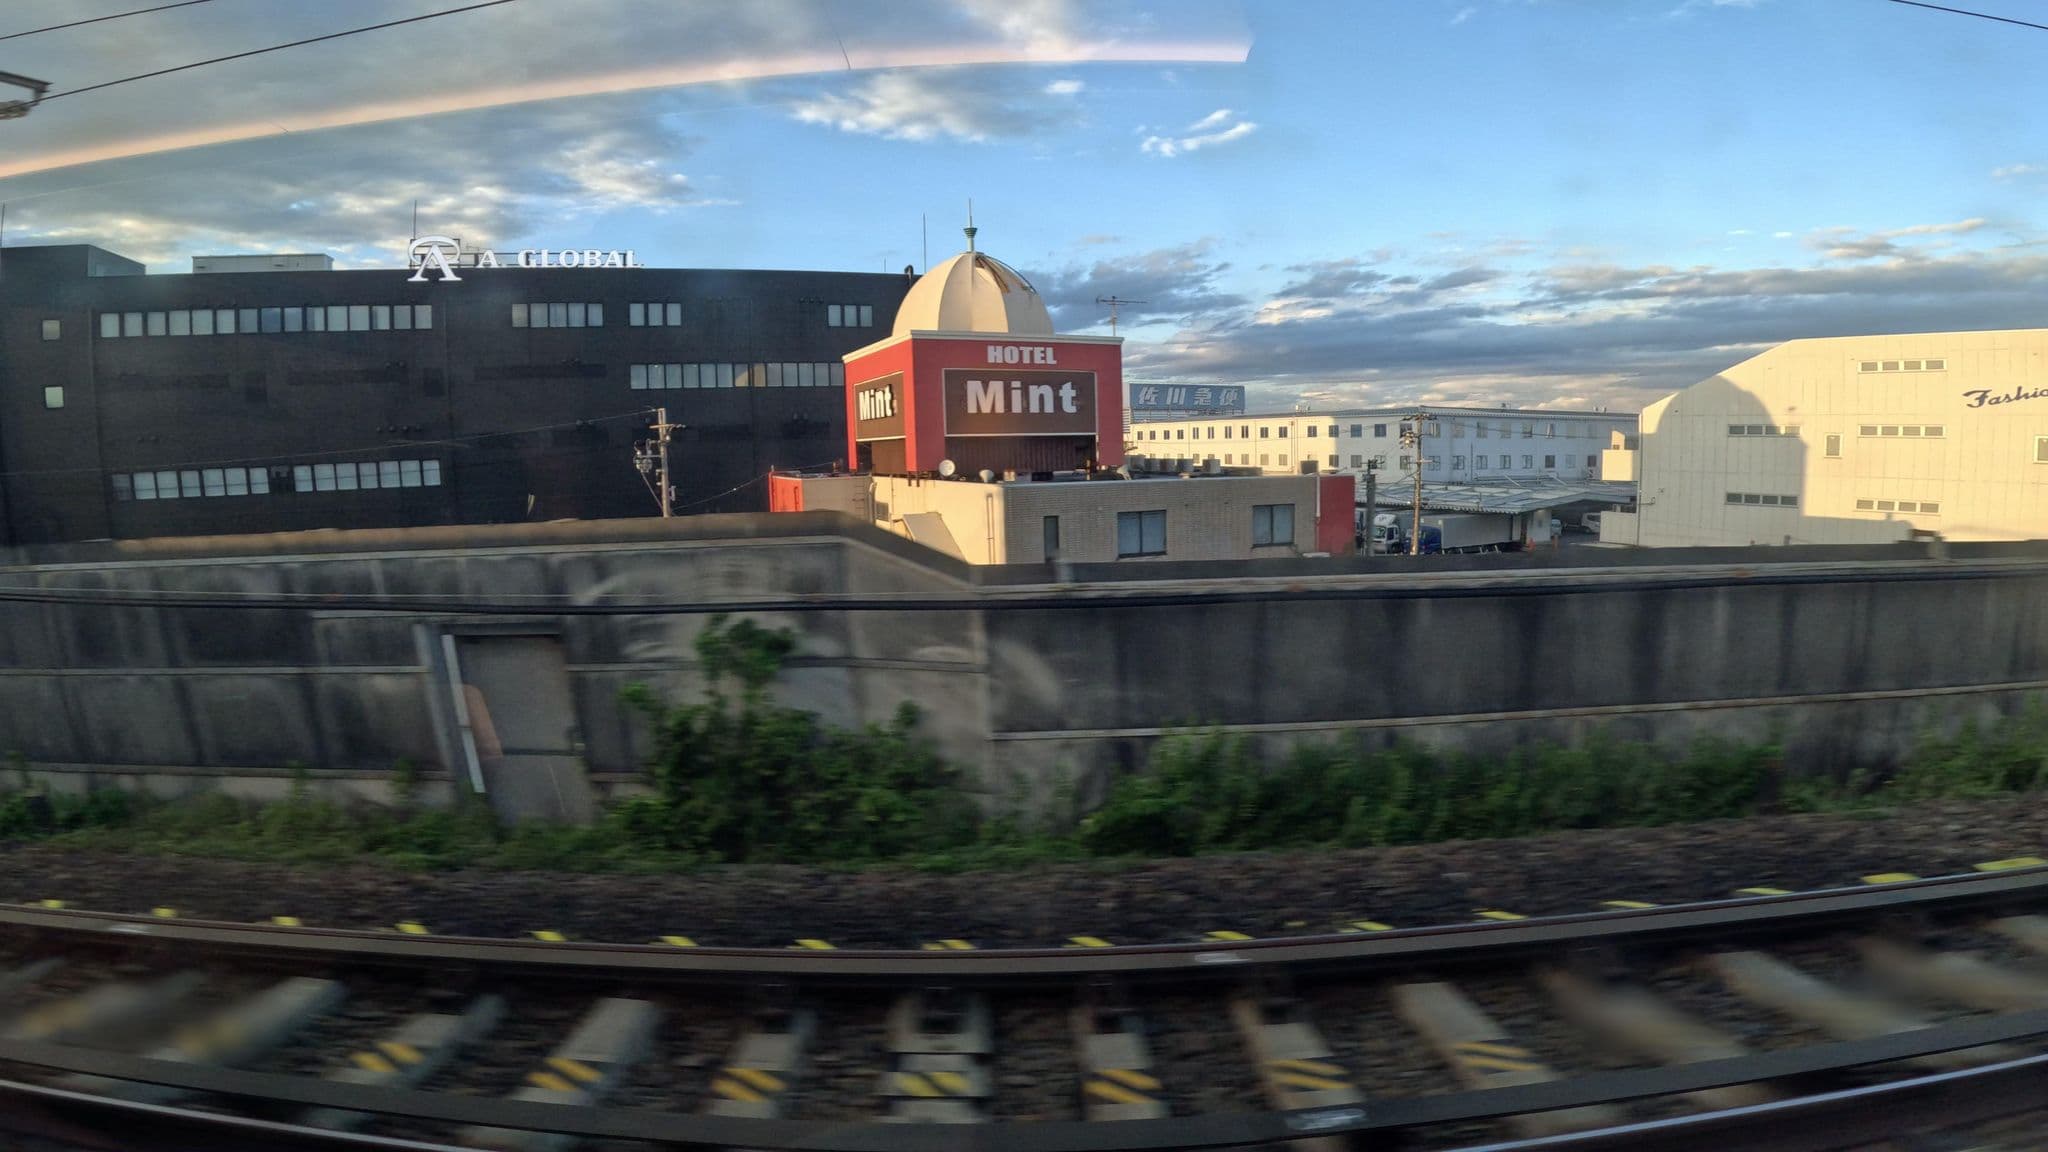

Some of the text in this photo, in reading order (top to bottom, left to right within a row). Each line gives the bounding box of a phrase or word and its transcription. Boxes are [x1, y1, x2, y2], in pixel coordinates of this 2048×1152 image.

[517, 249, 642, 268] GLOBAL
[987, 345, 1057, 365] HOTEL
[859, 385, 892, 421] Mint
[966, 380, 1078, 414] Mint
[1138, 386, 1239, 406] 佐川急便
